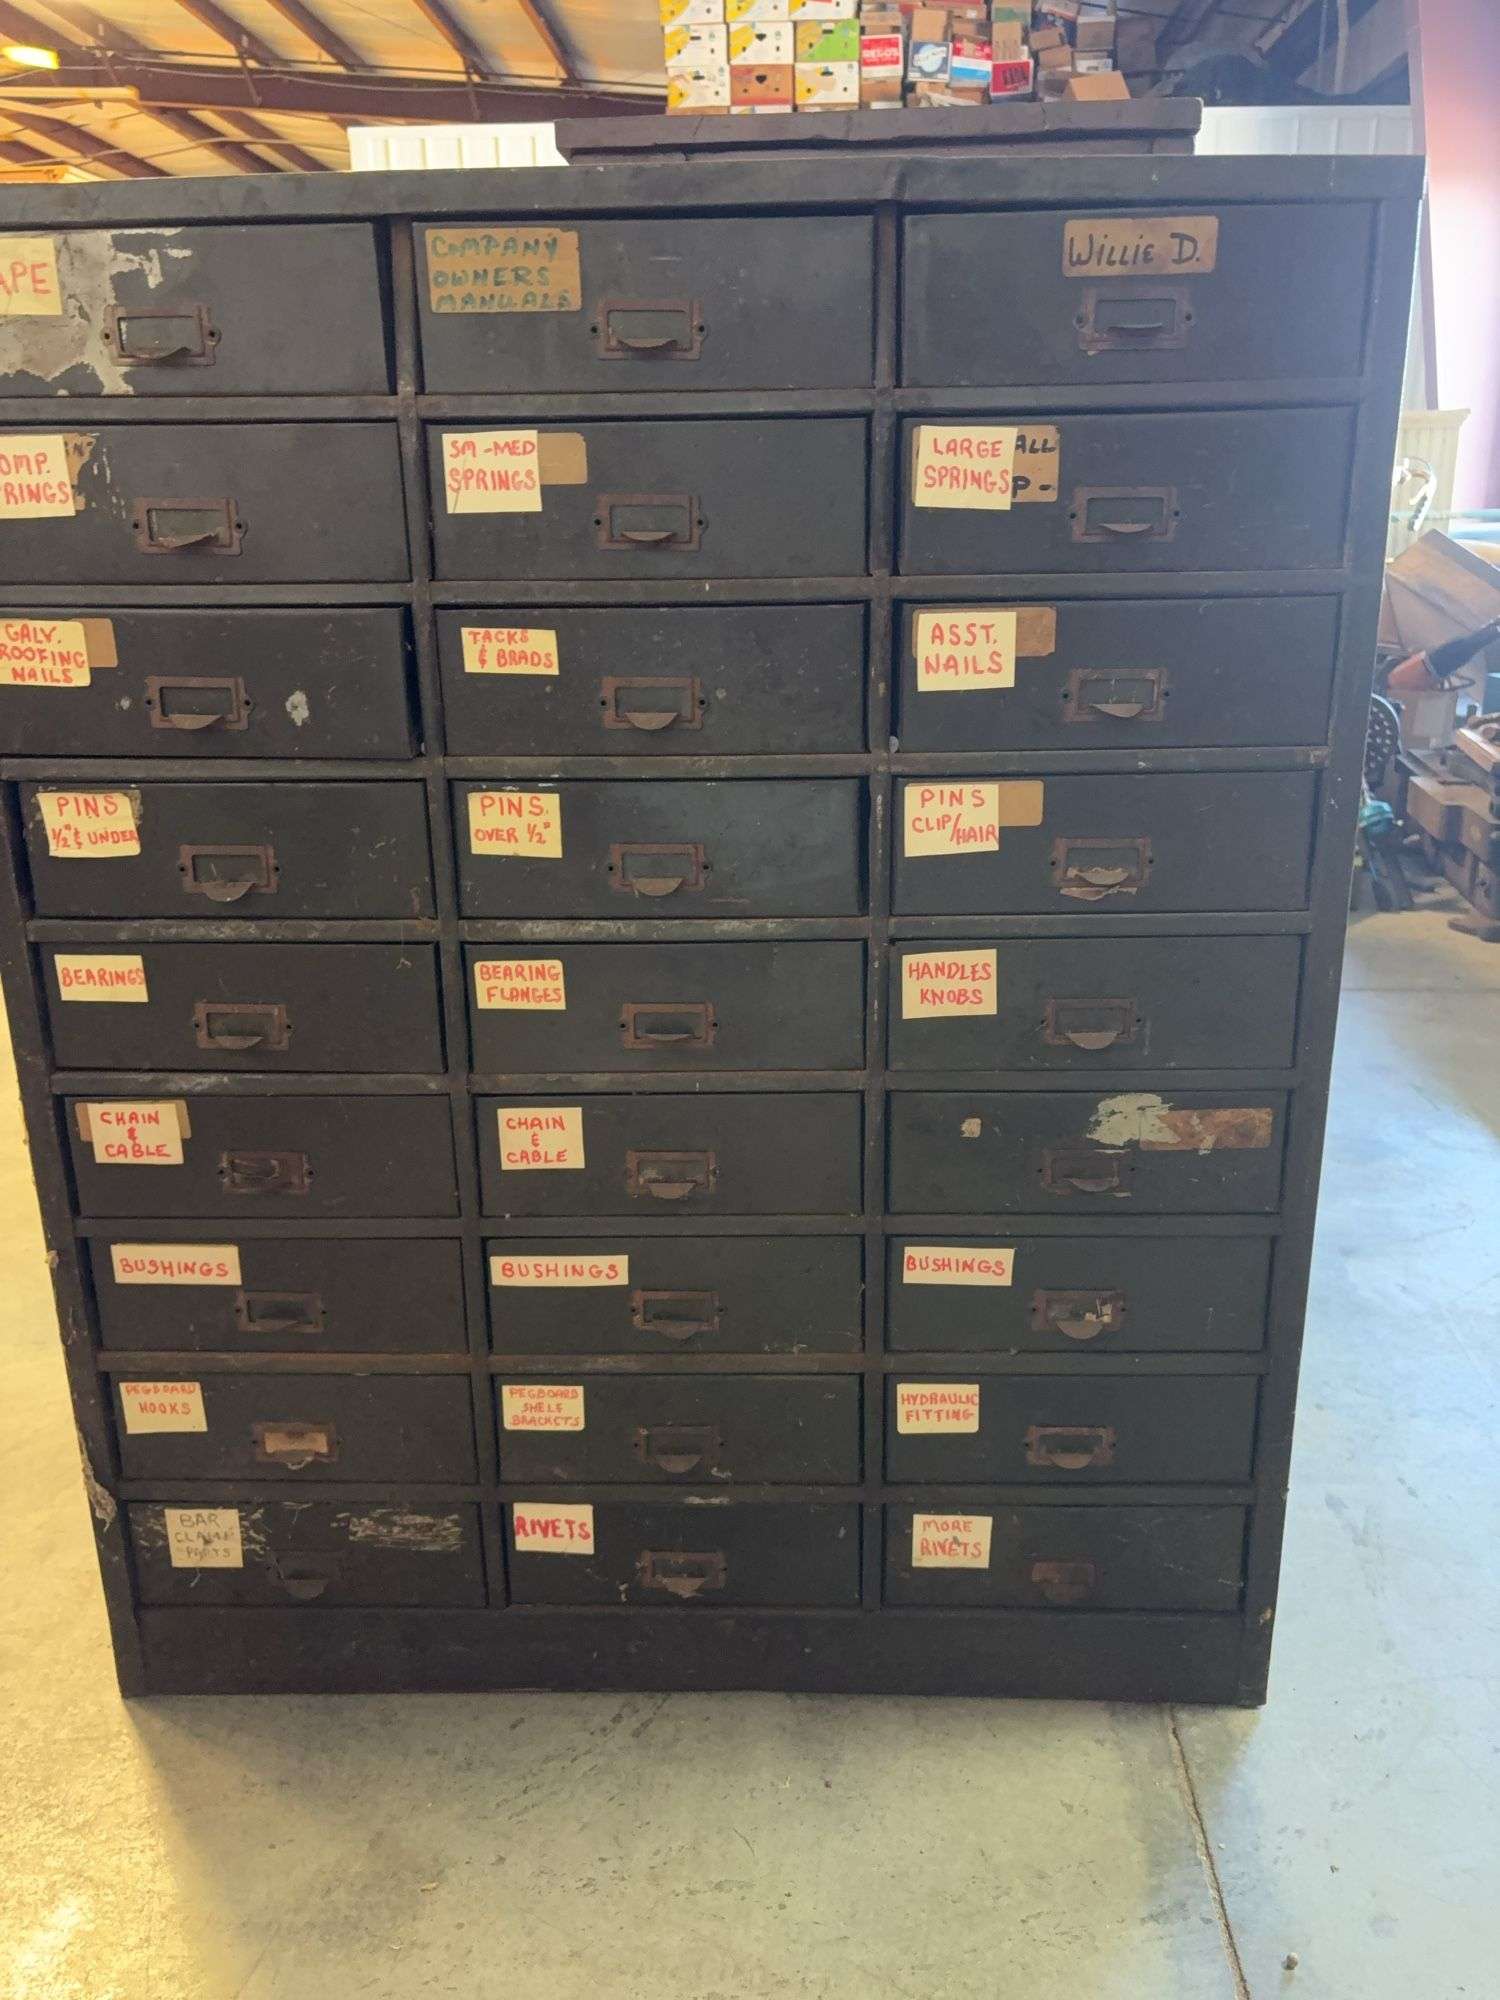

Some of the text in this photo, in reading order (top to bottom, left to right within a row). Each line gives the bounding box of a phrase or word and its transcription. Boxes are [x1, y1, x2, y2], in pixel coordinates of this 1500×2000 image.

[1169, 232, 1200, 265] D.
[432, 265, 550, 288] OWNERS
[932, 437, 1003, 459] LARGE
[448, 467, 537, 494] SPRINGS
[923, 465, 1010, 495] SPRINGS
[468, 629, 530, 645] TACKS
[931, 622, 997, 647] ASST.
[496, 648, 554, 669] BRADS
[924, 650, 1003, 676] NAILS
[11, 666, 73, 684] NAILS
[56, 794, 119, 818] PINS
[920, 788, 986, 809] PINS
[86, 829, 142, 846] UNDER
[473, 827, 519, 844] OVER
[61, 966, 146, 988] BEARINGS
[480, 963, 560, 982] BEARING
[908, 961, 993, 982] HANDLES
[486, 986, 563, 1004] FLANGES
[920, 987, 983, 1006] KNOBS
[100, 1110, 160, 1126] CHAIN
[506, 1115, 566, 1131] CHAIN
[105, 1143, 171, 1159] CABLE
[506, 1149, 568, 1165] CABLE
[120, 1258, 229, 1277] BUSHINGS
[501, 1262, 618, 1279] BUSHINGS
[906, 1254, 1006, 1276] BUSHINGS
[521, 1402, 563, 1414] SHELF
[901, 1391, 978, 1406] HYDRAULIC
[139, 1402, 191, 1416] HOOKS
[905, 1408, 974, 1423] FITTING
[180, 1512, 221, 1529] BAR
[515, 1514, 591, 1541] RIVETS
[922, 1519, 973, 1533] MORE
[920, 1537, 982, 1558] RIVETS
